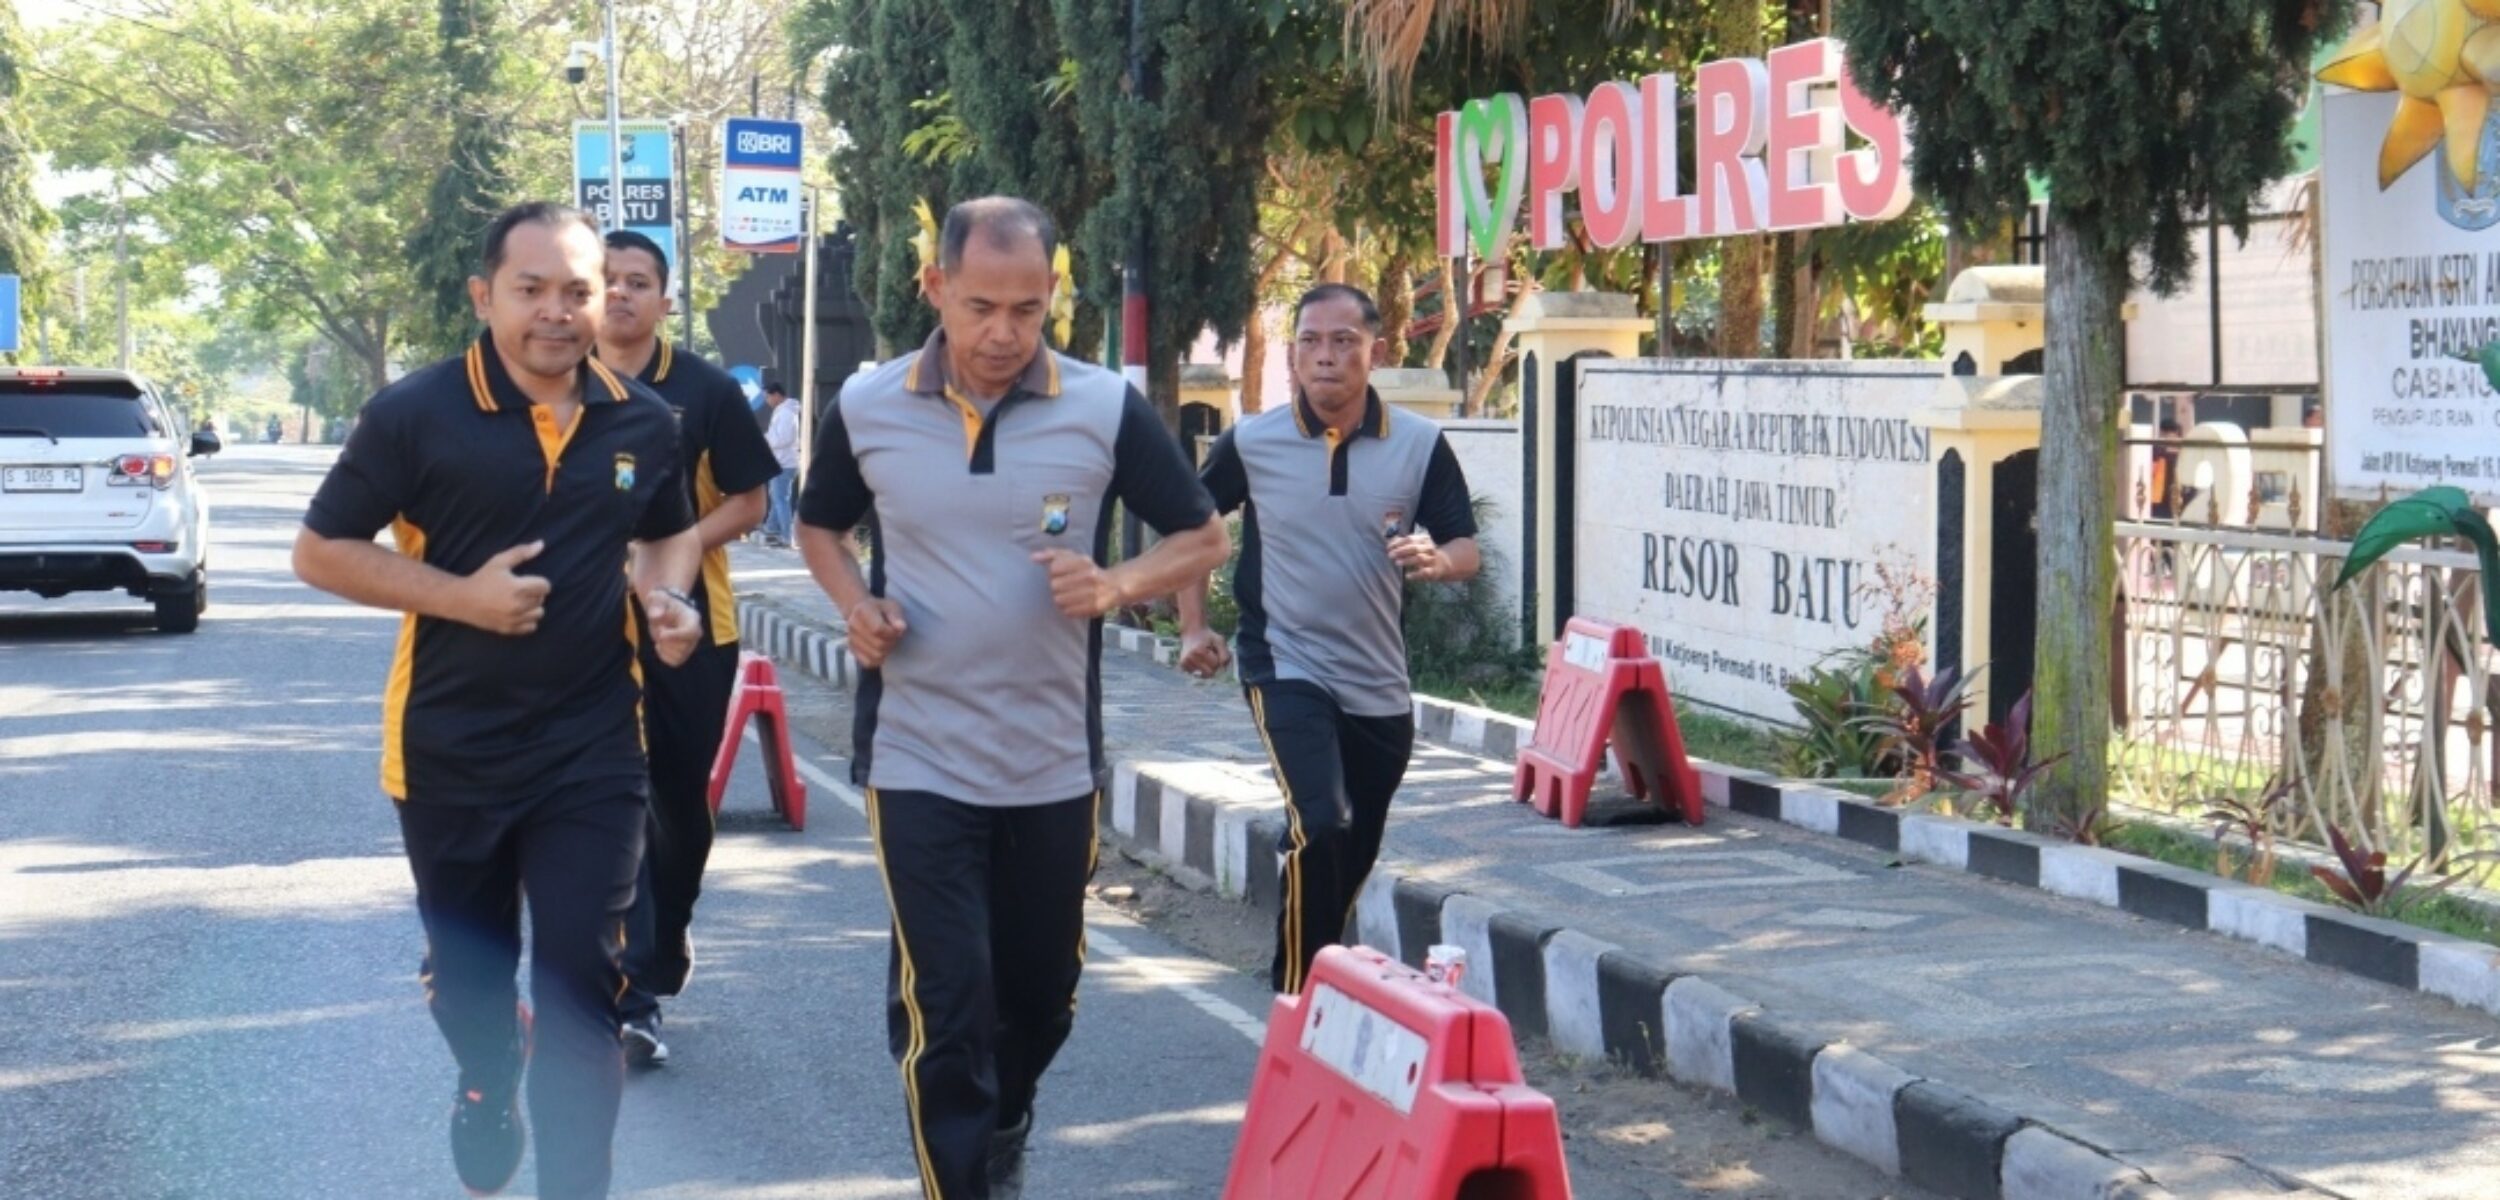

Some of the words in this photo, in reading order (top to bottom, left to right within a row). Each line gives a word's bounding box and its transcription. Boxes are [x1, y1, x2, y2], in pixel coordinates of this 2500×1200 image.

[759, 134, 791, 153] BRI
[1529, 36, 1914, 251] POLRES
[587, 184, 665, 200] PORES
[738, 187, 788, 204] ATM
[1590, 404, 1675, 444] KEPOLISIAN
[1675, 404, 1743, 450] NEGARA
[1836, 416, 1931, 462] INDONESI
[1665, 472, 1728, 515] DAERAH
[1732, 479, 1773, 523] JAWA
[1776, 483, 1837, 530] TIMUR
[1642, 532, 1740, 608] RESOR
[1771, 550, 1863, 630] BATU
[1711, 650, 1756, 681] Permadi
